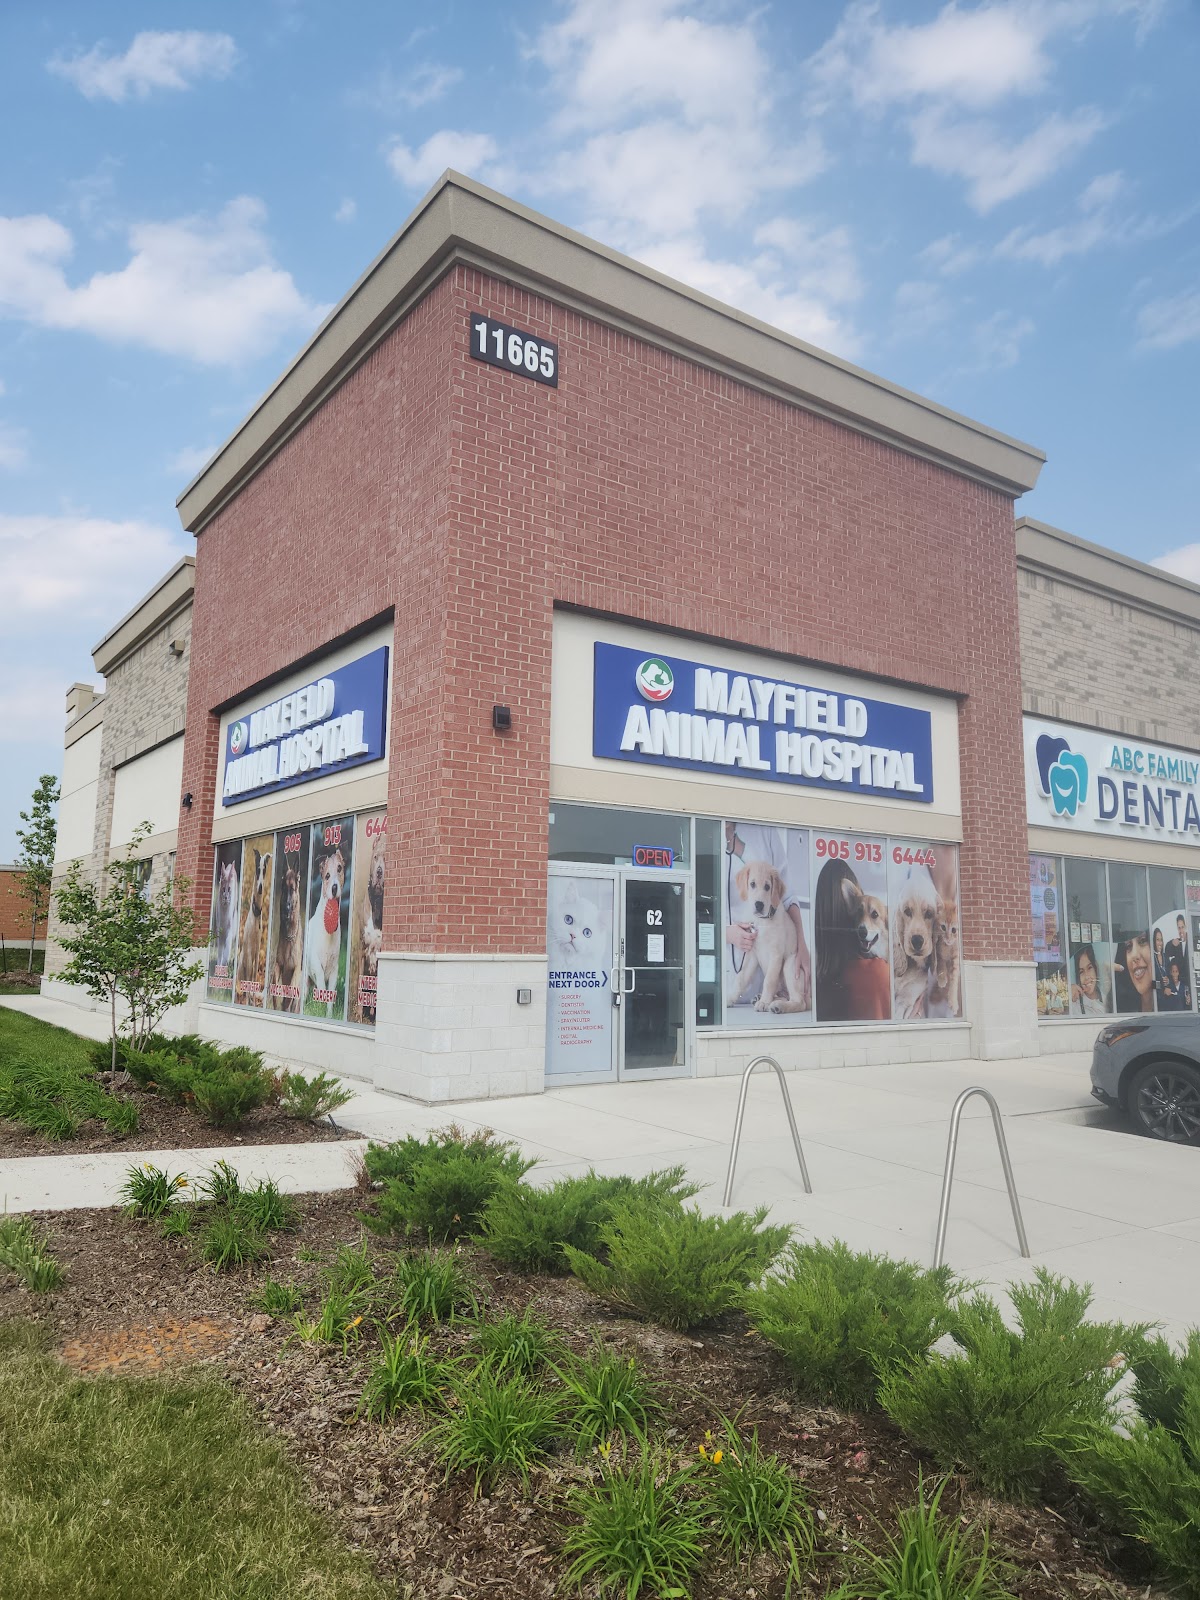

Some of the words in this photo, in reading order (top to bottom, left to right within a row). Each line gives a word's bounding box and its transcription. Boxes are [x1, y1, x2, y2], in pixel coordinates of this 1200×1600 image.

[475, 322, 554, 378] 11665
[249, 678, 336, 748] MAYFIELD
[695, 667, 868, 738] MAYFIELD
[223, 745, 281, 798] ANIMAL
[279, 709, 369, 781] HOSPITAL
[620, 704, 771, 771] ANIMAL
[775, 730, 924, 793] HOSPITAL
[1110, 745, 1145, 774] ABC
[1147, 753, 1199, 785] FAMILY
[284, 833, 301, 853] 905
[324, 825, 341, 846] 913
[816, 838, 850, 859] 905
[855, 842, 882, 863] 913
[892, 846, 936, 868] 6444
[635, 848, 672, 867] OPEN
[646, 909, 663, 926] 62
[548, 980, 573, 989] NEXT
[574, 980, 600, 988] DOOR
[549, 971, 597, 980] ENTRANCE
[313, 987, 337, 1003] SURGERY
